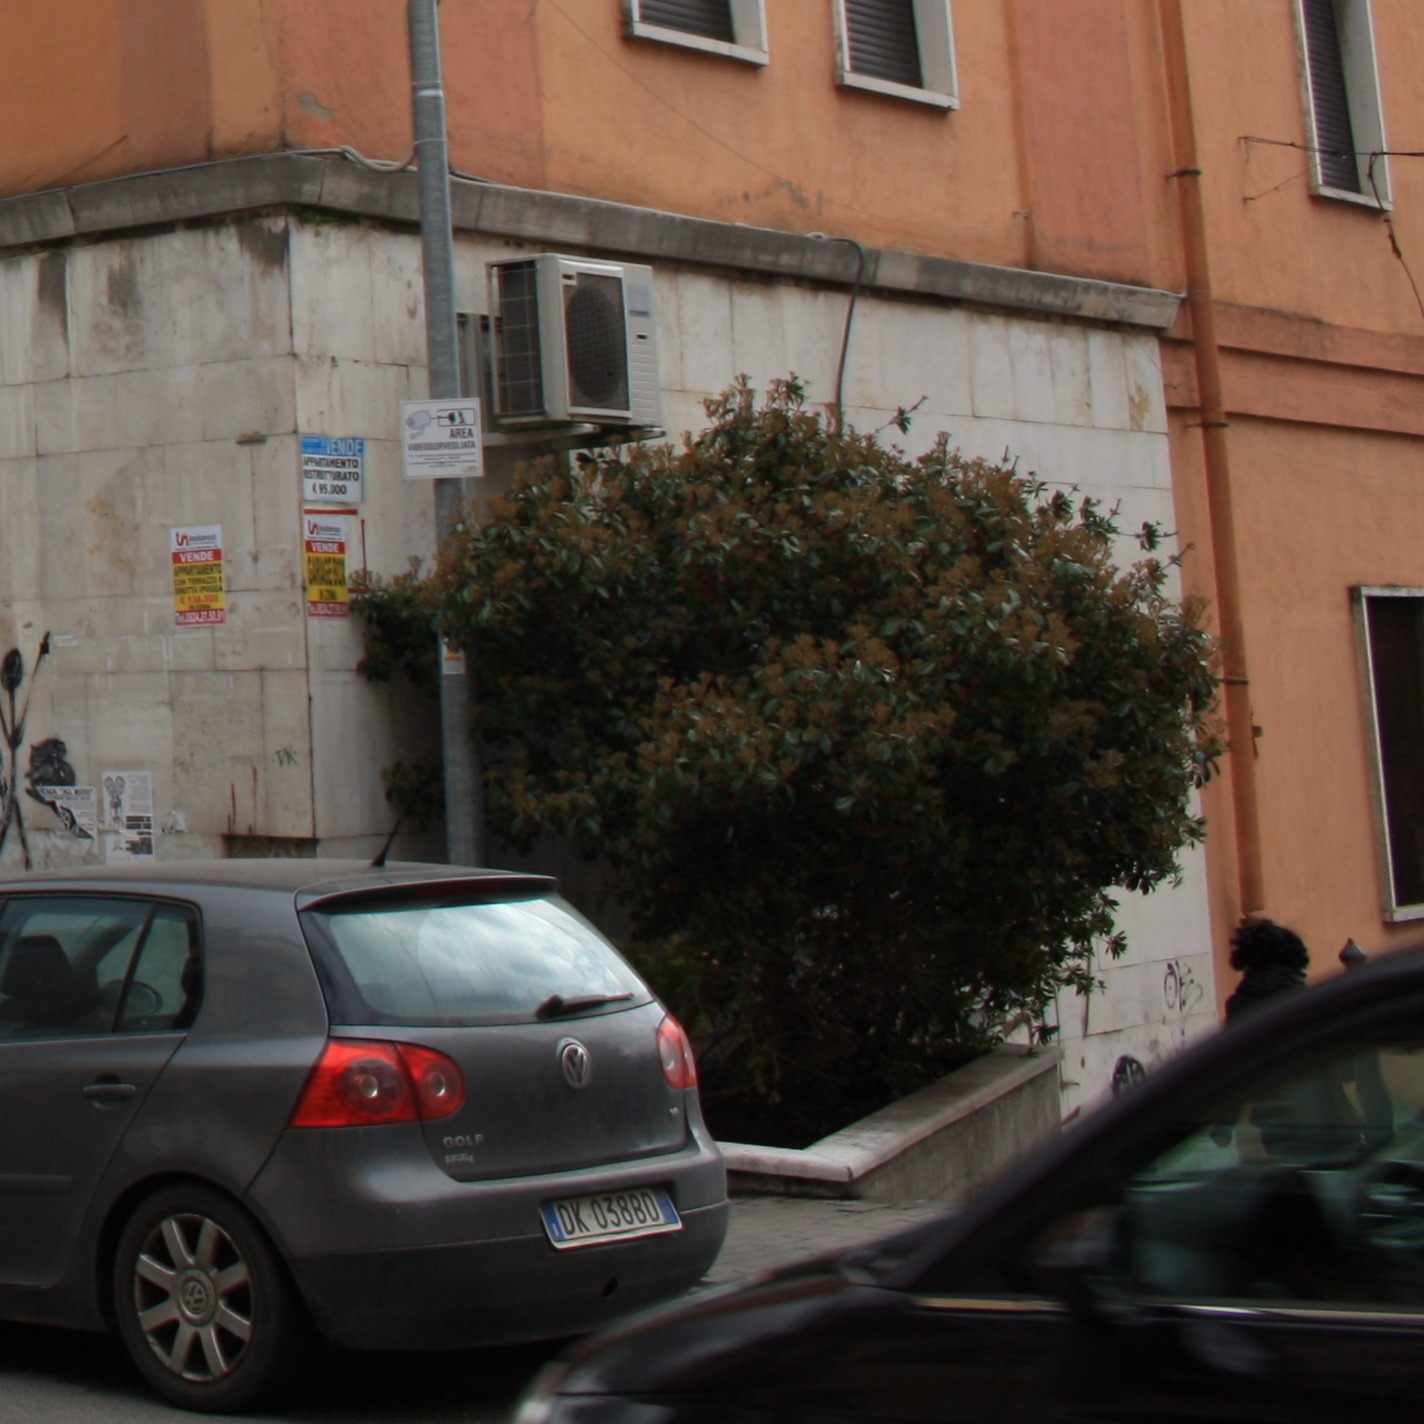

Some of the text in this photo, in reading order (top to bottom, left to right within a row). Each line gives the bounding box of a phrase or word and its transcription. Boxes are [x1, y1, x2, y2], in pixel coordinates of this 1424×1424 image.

[448, 427, 474, 439] AREA
[310, 542, 340, 553] VENDE
[179, 550, 214, 563] VENDE
[442, 1133, 484, 1149] GOLF
[556, 1200, 590, 1236] DK
